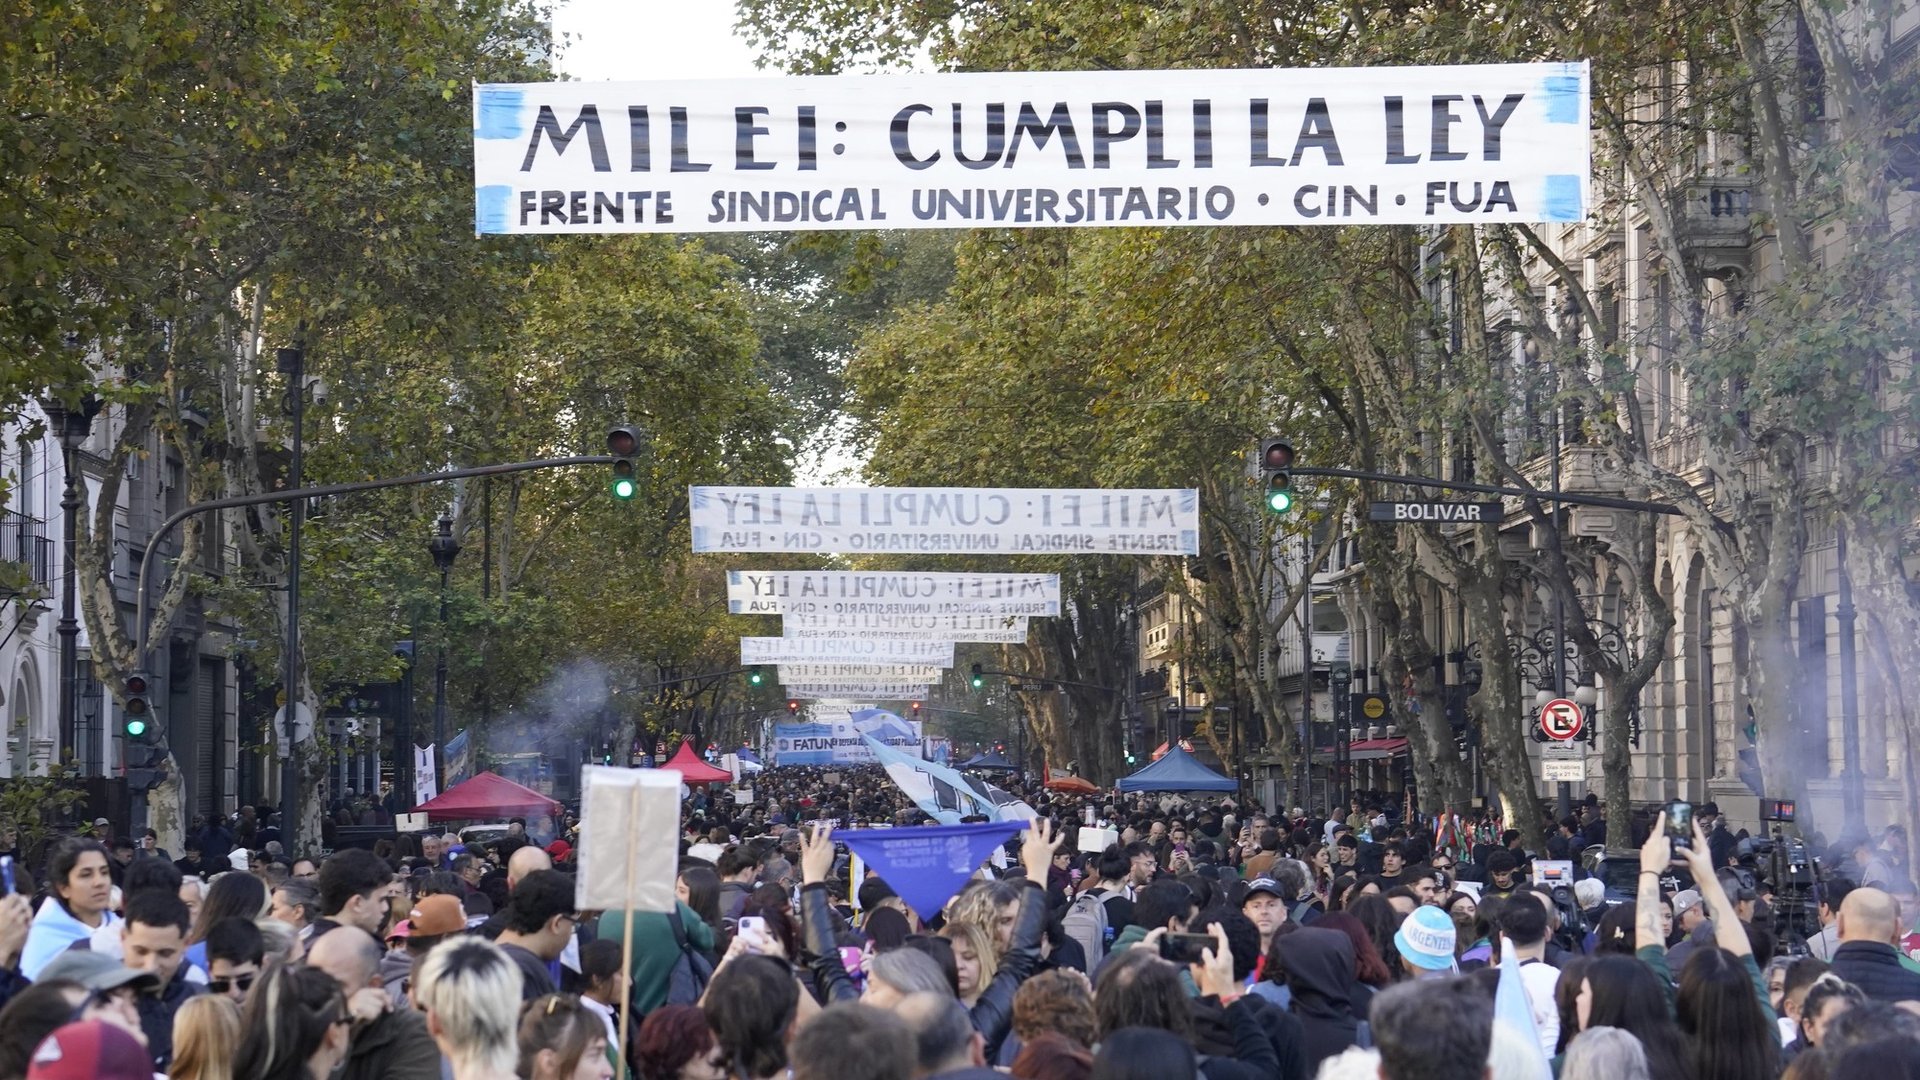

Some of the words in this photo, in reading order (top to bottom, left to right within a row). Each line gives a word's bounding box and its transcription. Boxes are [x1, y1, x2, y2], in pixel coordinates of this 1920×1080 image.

[520, 103, 846, 172] MILEI:
[889, 99, 1212, 170] CUMPLI
[1250, 98, 1344, 167] LA
[1384, 94, 1525, 165] LEY
[520, 190, 673, 225] FRENTE
[708, 188, 886, 223] SINDICAL
[912, 185, 1235, 222] UNIVERSITARIO
[1294, 184, 1378, 218] CIN
[1424, 181, 1518, 215] FUA
[1394, 503, 1481, 520] BOLIVAR
[793, 738, 833, 750] FATUN
